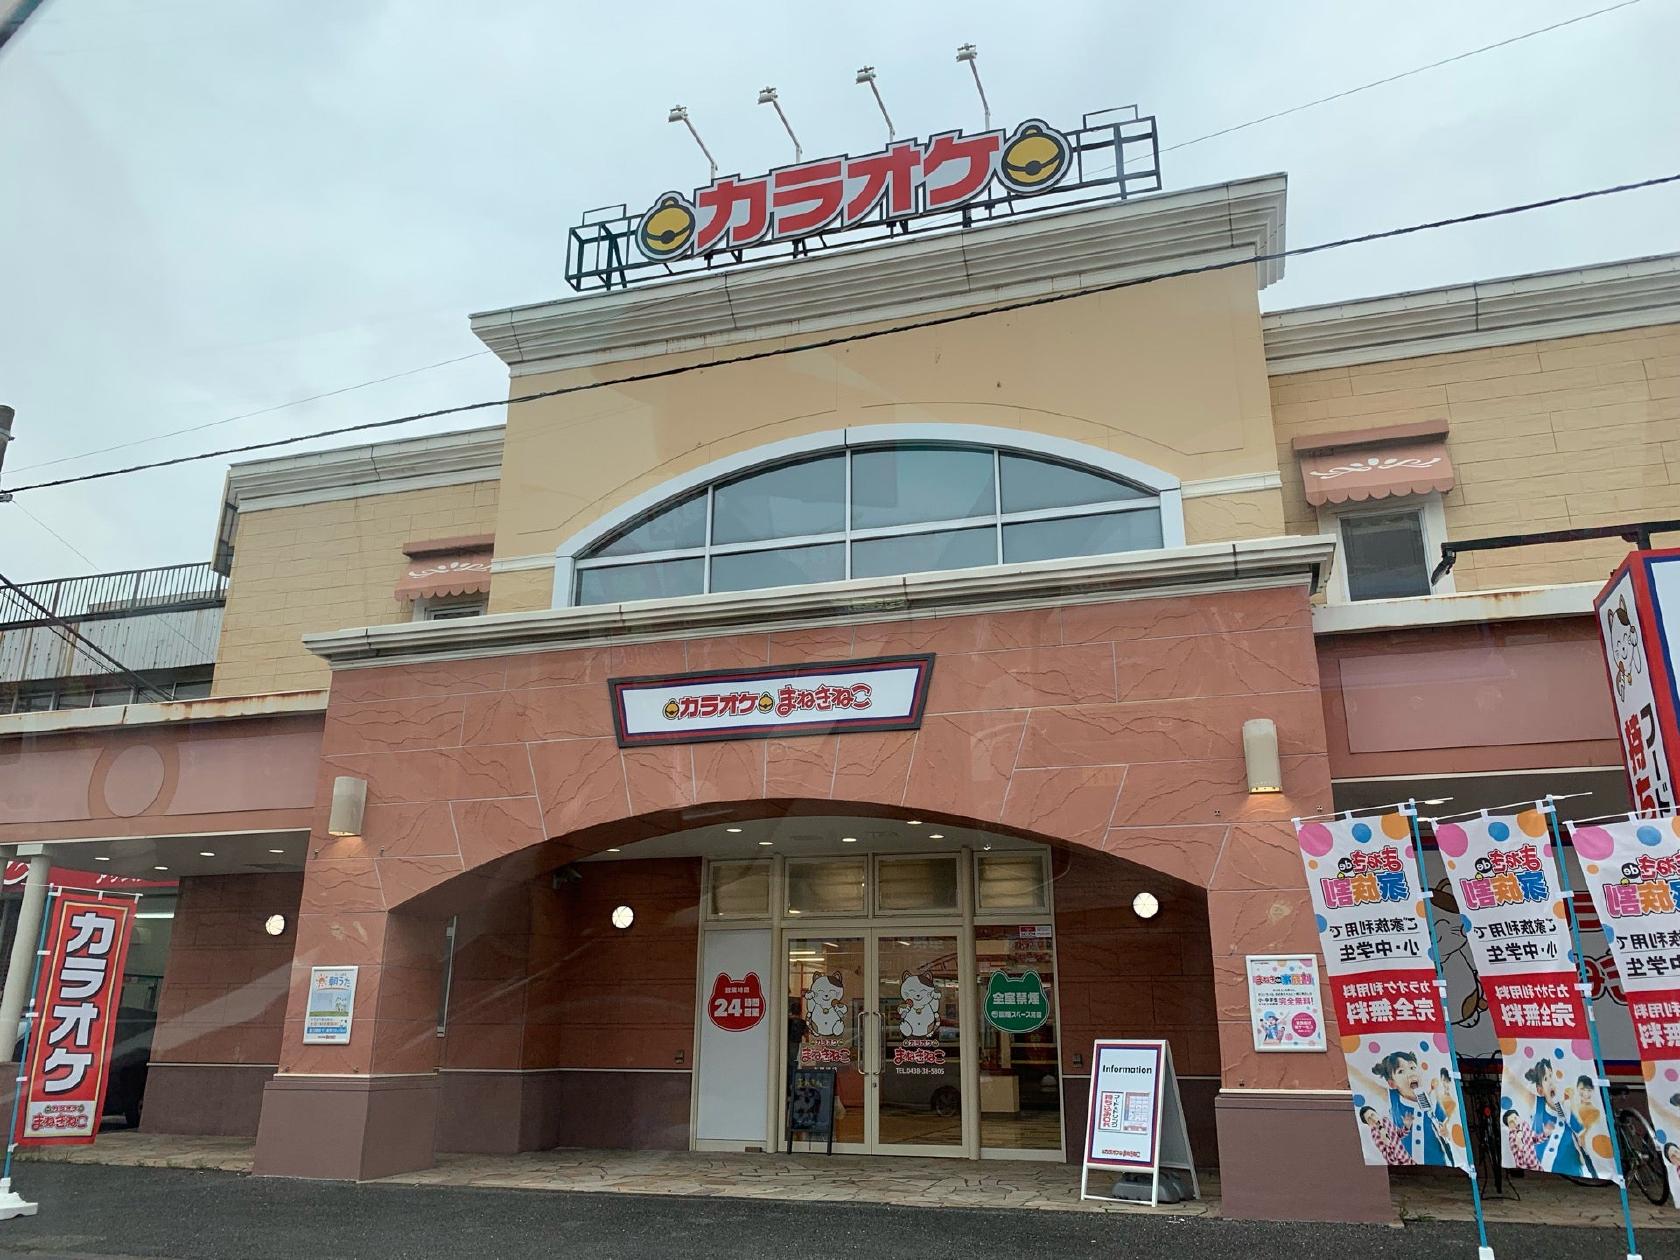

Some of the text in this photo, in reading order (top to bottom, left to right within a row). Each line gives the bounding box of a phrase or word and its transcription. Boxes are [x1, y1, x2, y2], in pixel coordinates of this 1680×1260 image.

[694, 131, 1003, 254] カラオケ
[678, 685, 872, 719] カラオケ まねきねこ
[44, 911, 116, 1094] カラオケ
[714, 998, 743, 1017] 24
[801, 1046, 851, 1063] まねきねこ
[894, 1046, 946, 1065] まねきねこ
[1102, 1064, 1152, 1075] Information
